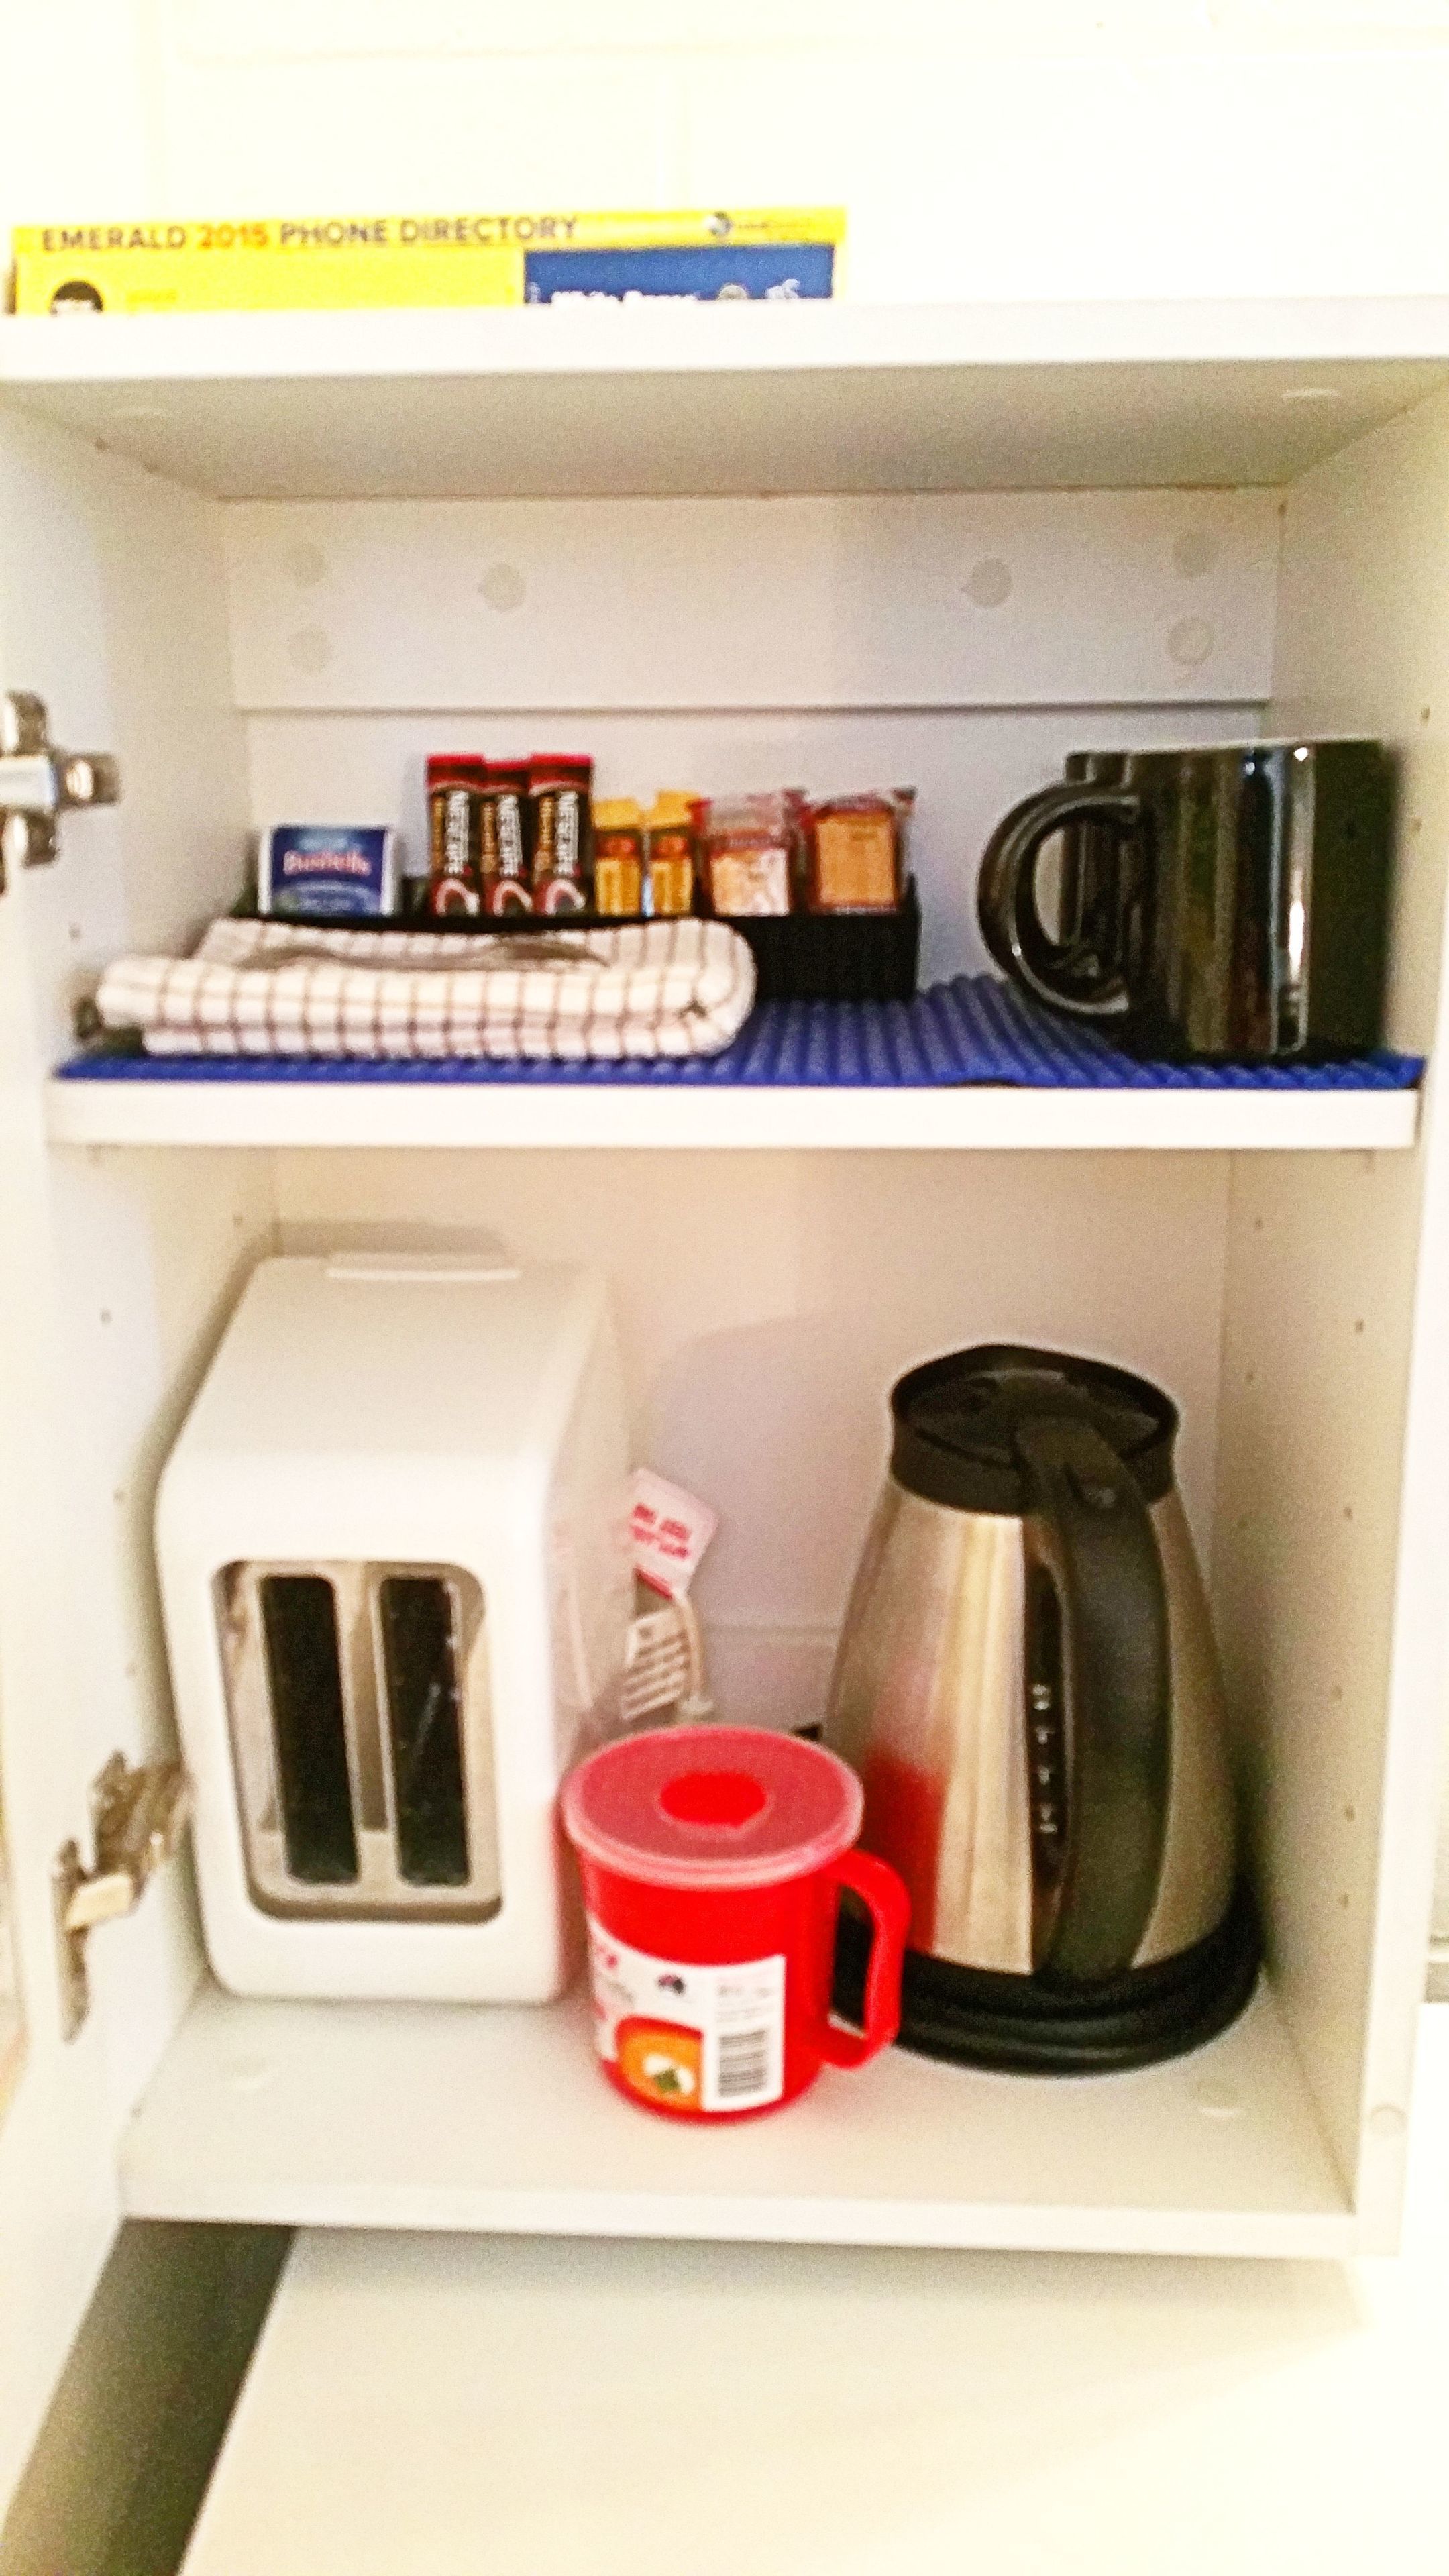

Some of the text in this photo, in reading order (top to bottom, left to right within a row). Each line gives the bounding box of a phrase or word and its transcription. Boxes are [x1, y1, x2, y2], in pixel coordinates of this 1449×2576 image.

[42, 215, 578, 252] EMERALD 2015 PHONE DIRECTORY
